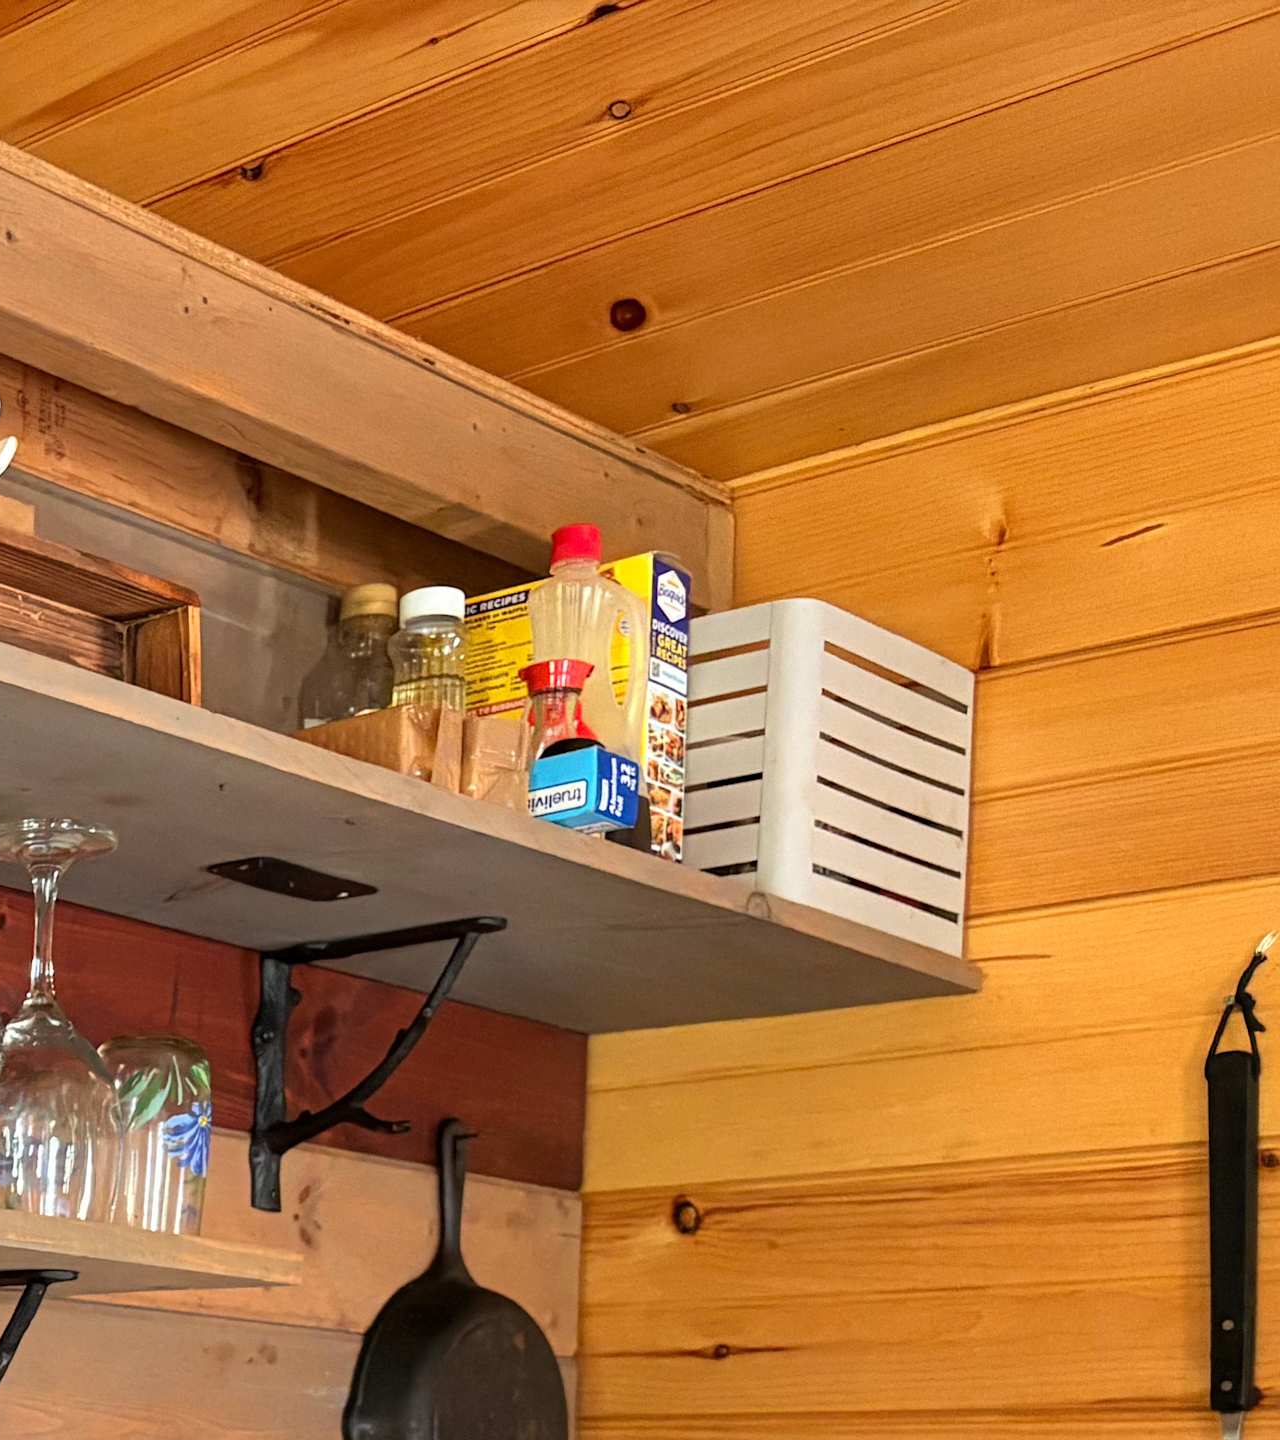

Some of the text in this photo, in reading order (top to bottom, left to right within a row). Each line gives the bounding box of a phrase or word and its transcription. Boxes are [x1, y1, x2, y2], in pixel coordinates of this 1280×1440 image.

[479, 592, 526, 612] RECIPES
[652, 618, 688, 646] DISCOVER
[657, 633, 688, 658] GREAT
[656, 647, 687, 670] RECIPES
[528, 787, 582, 812] truelivi
